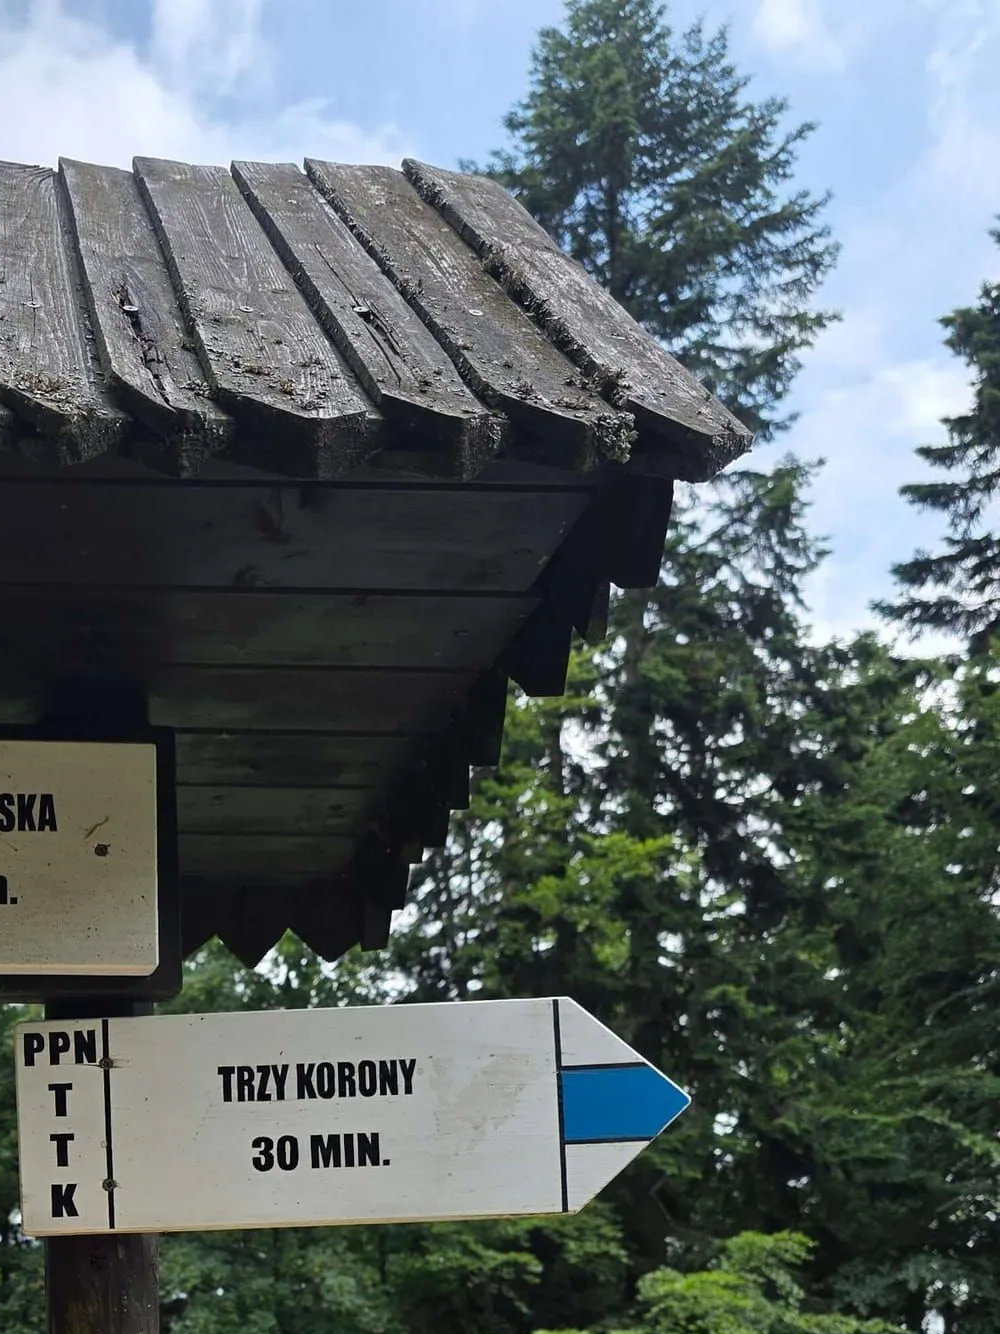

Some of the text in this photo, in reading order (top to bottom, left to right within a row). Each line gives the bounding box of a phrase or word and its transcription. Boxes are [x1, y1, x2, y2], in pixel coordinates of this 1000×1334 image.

[24, 1030, 96, 1066] PPN
[217, 1059, 416, 1102] TRZY KORONY
[252, 1133, 390, 1172] 30 MIN.
